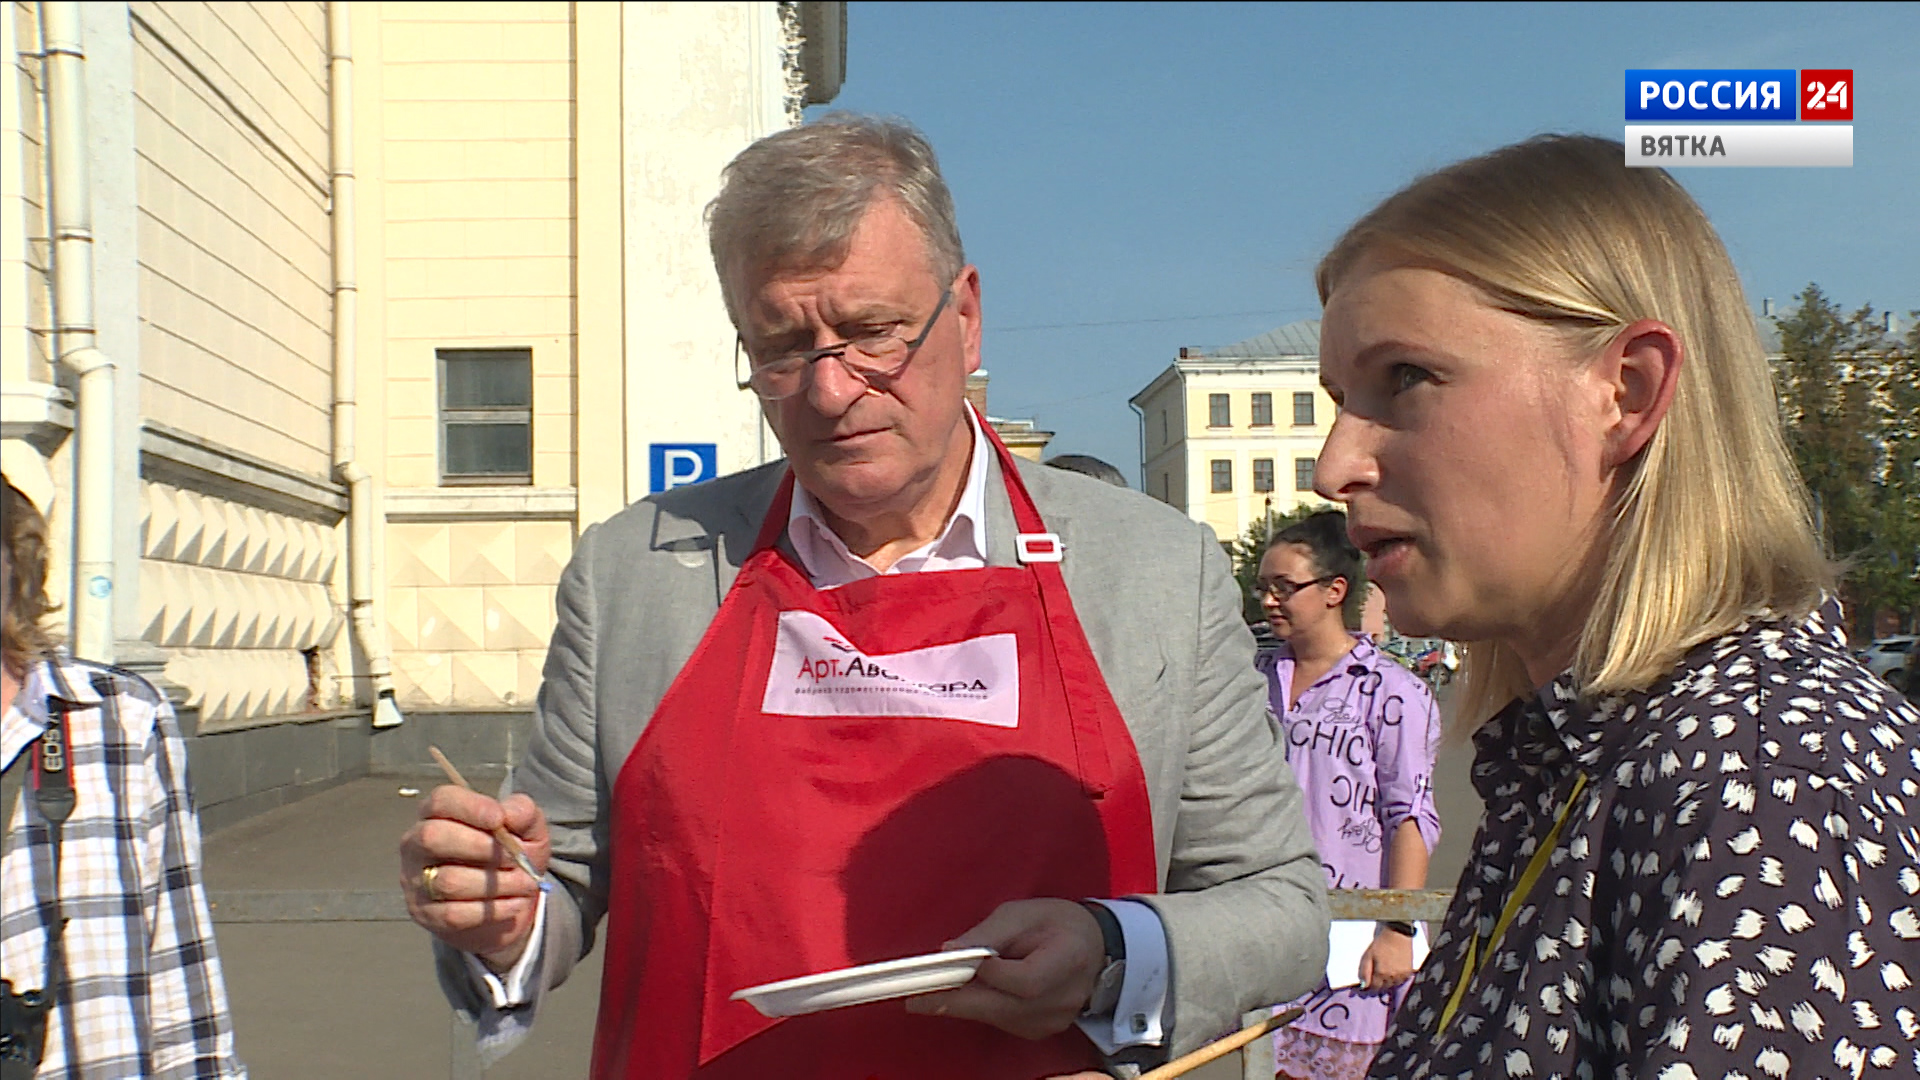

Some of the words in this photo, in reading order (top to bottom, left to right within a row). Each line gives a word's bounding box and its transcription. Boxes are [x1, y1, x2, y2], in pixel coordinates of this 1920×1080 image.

[664, 449, 703, 491] P
[42, 728, 63, 772] EOS
[1290, 719, 1364, 766] CHIC
